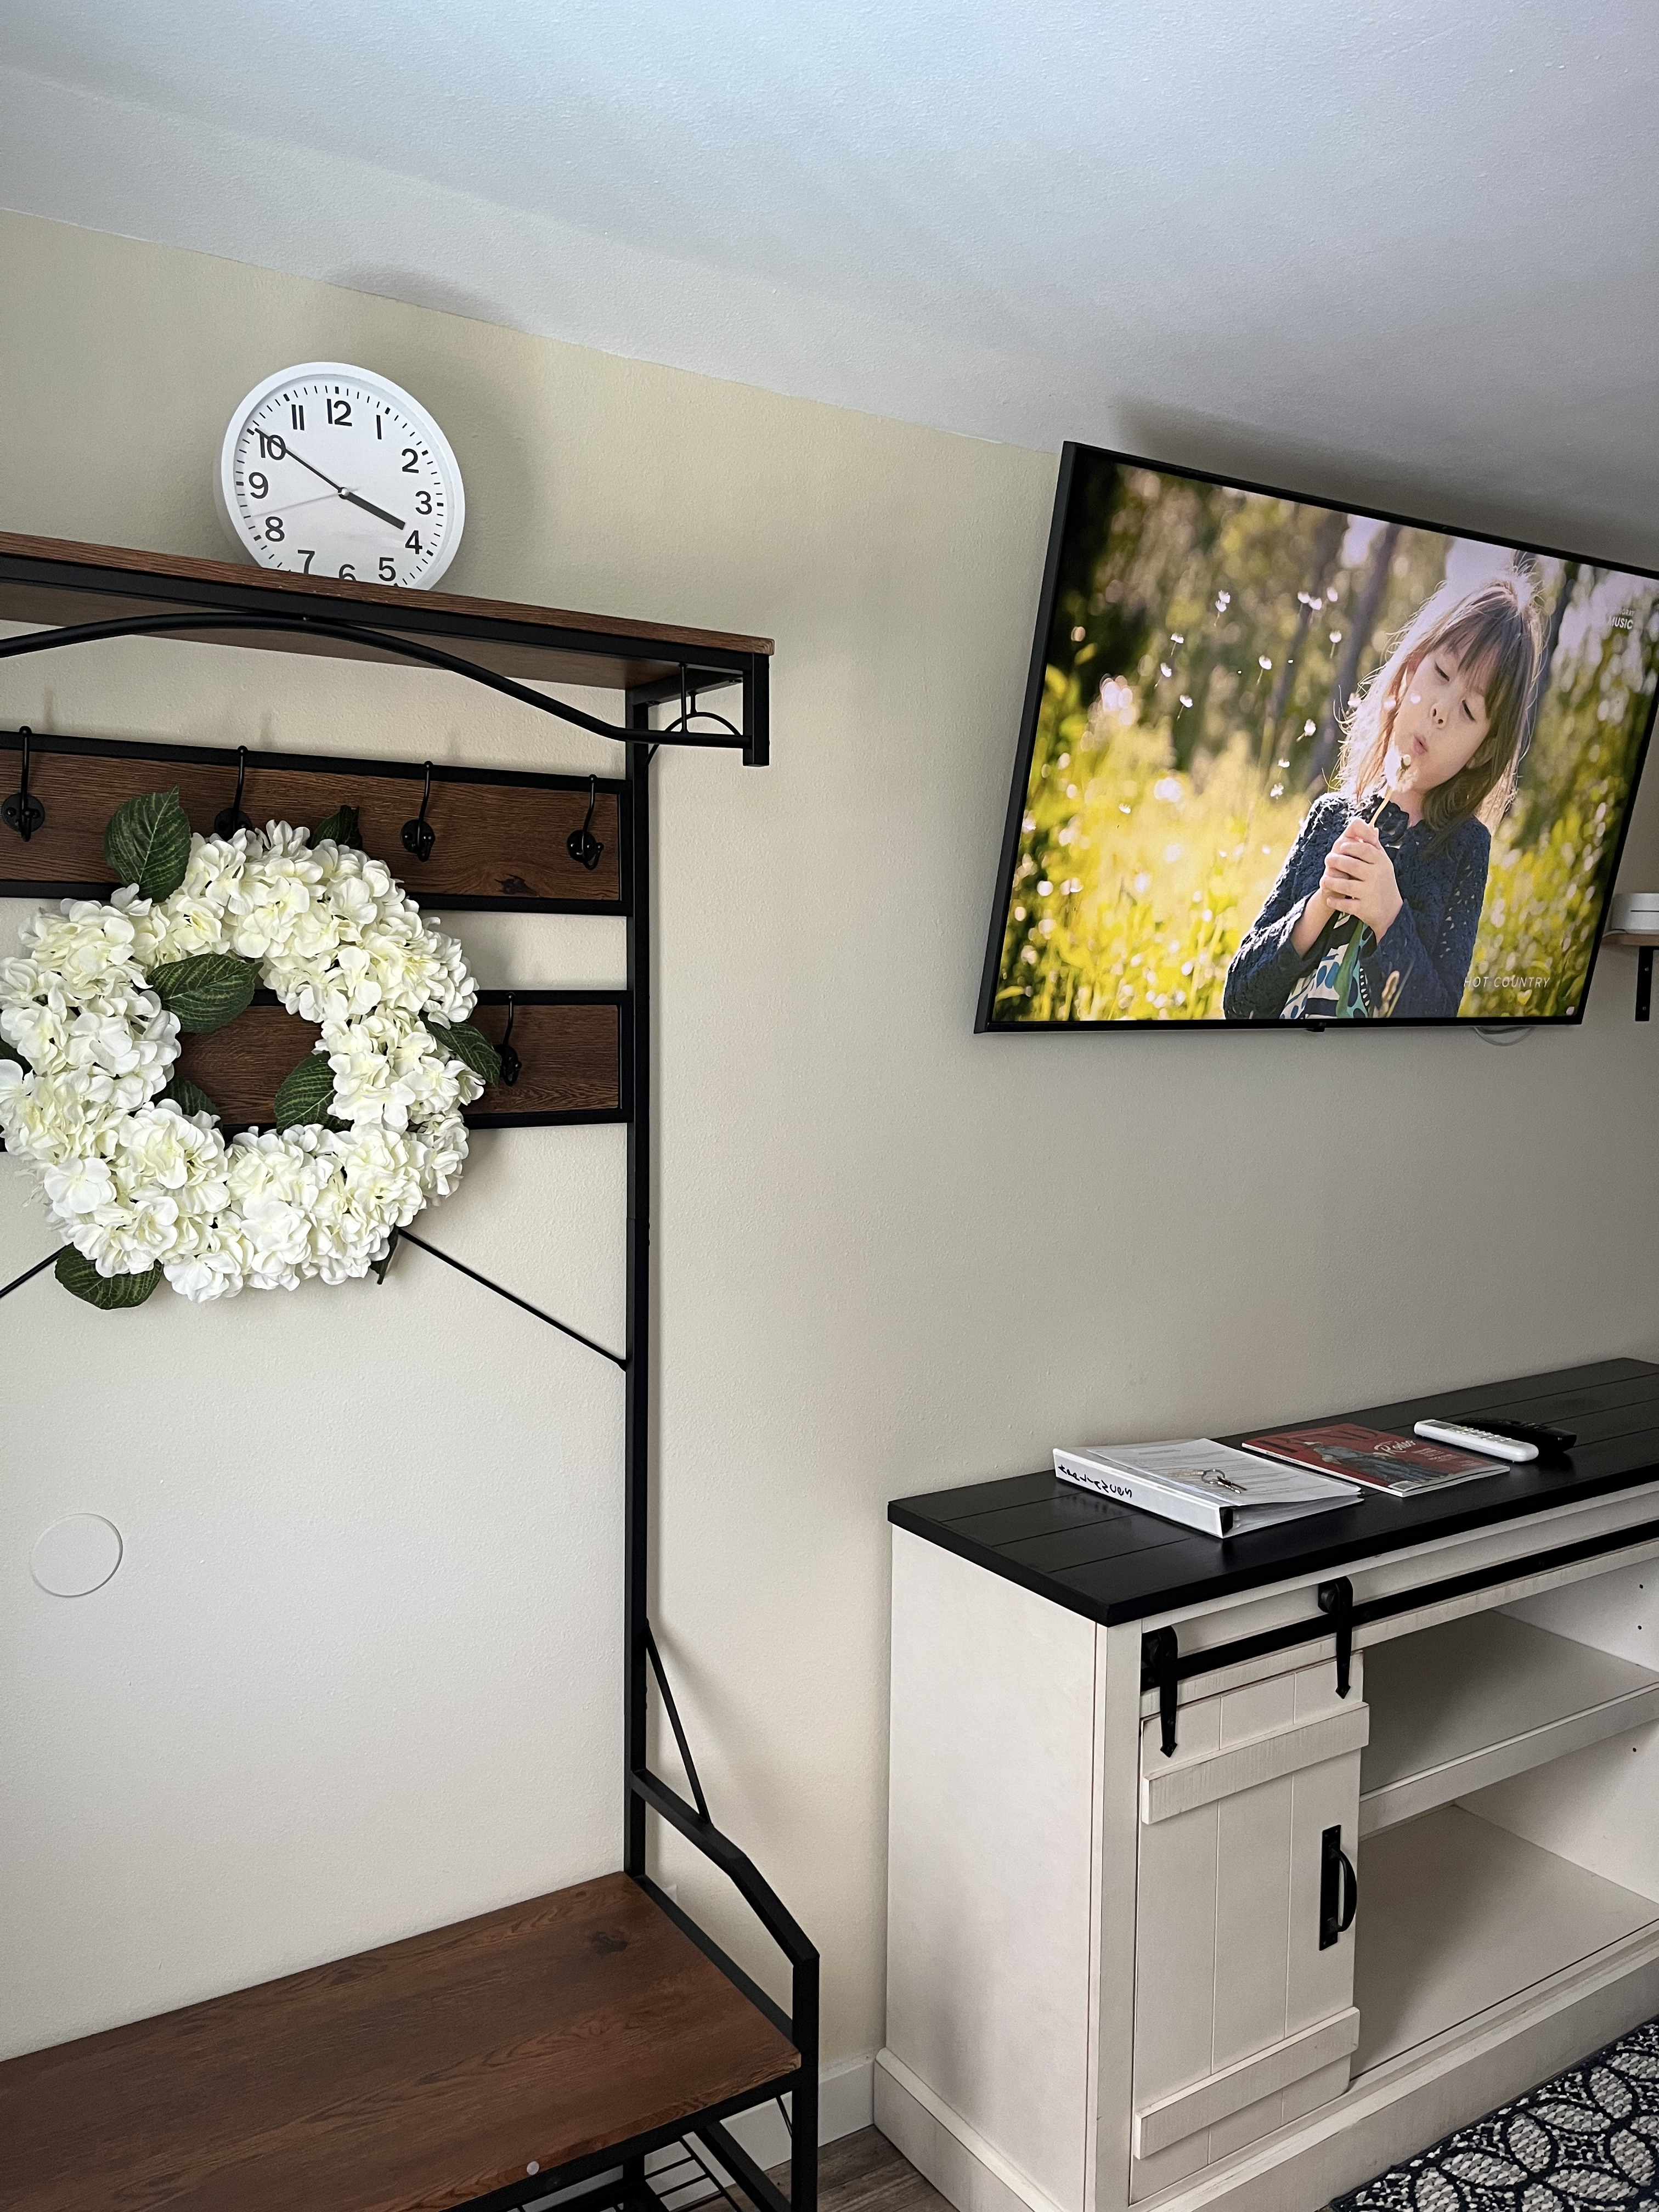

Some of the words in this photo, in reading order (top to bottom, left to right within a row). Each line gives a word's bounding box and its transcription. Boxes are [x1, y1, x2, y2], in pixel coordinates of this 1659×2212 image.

[291, 404, 304, 431] 11
[327, 399, 352, 426] 12
[376, 415, 382, 439] 1
[259, 434, 286, 460] 10
[402, 449, 419, 473] 2
[249, 472, 269, 499] 9
[415, 491, 432, 515] 3
[265, 516, 285, 542] 8
[405, 531, 423, 555] 4
[297, 550, 315, 574] 7
[378, 557, 396, 582] 5
[1608, 616, 1633, 629] MUSIC
[1464, 976, 1489, 988] HOT
[1493, 976, 1550, 989] COUNTRY
